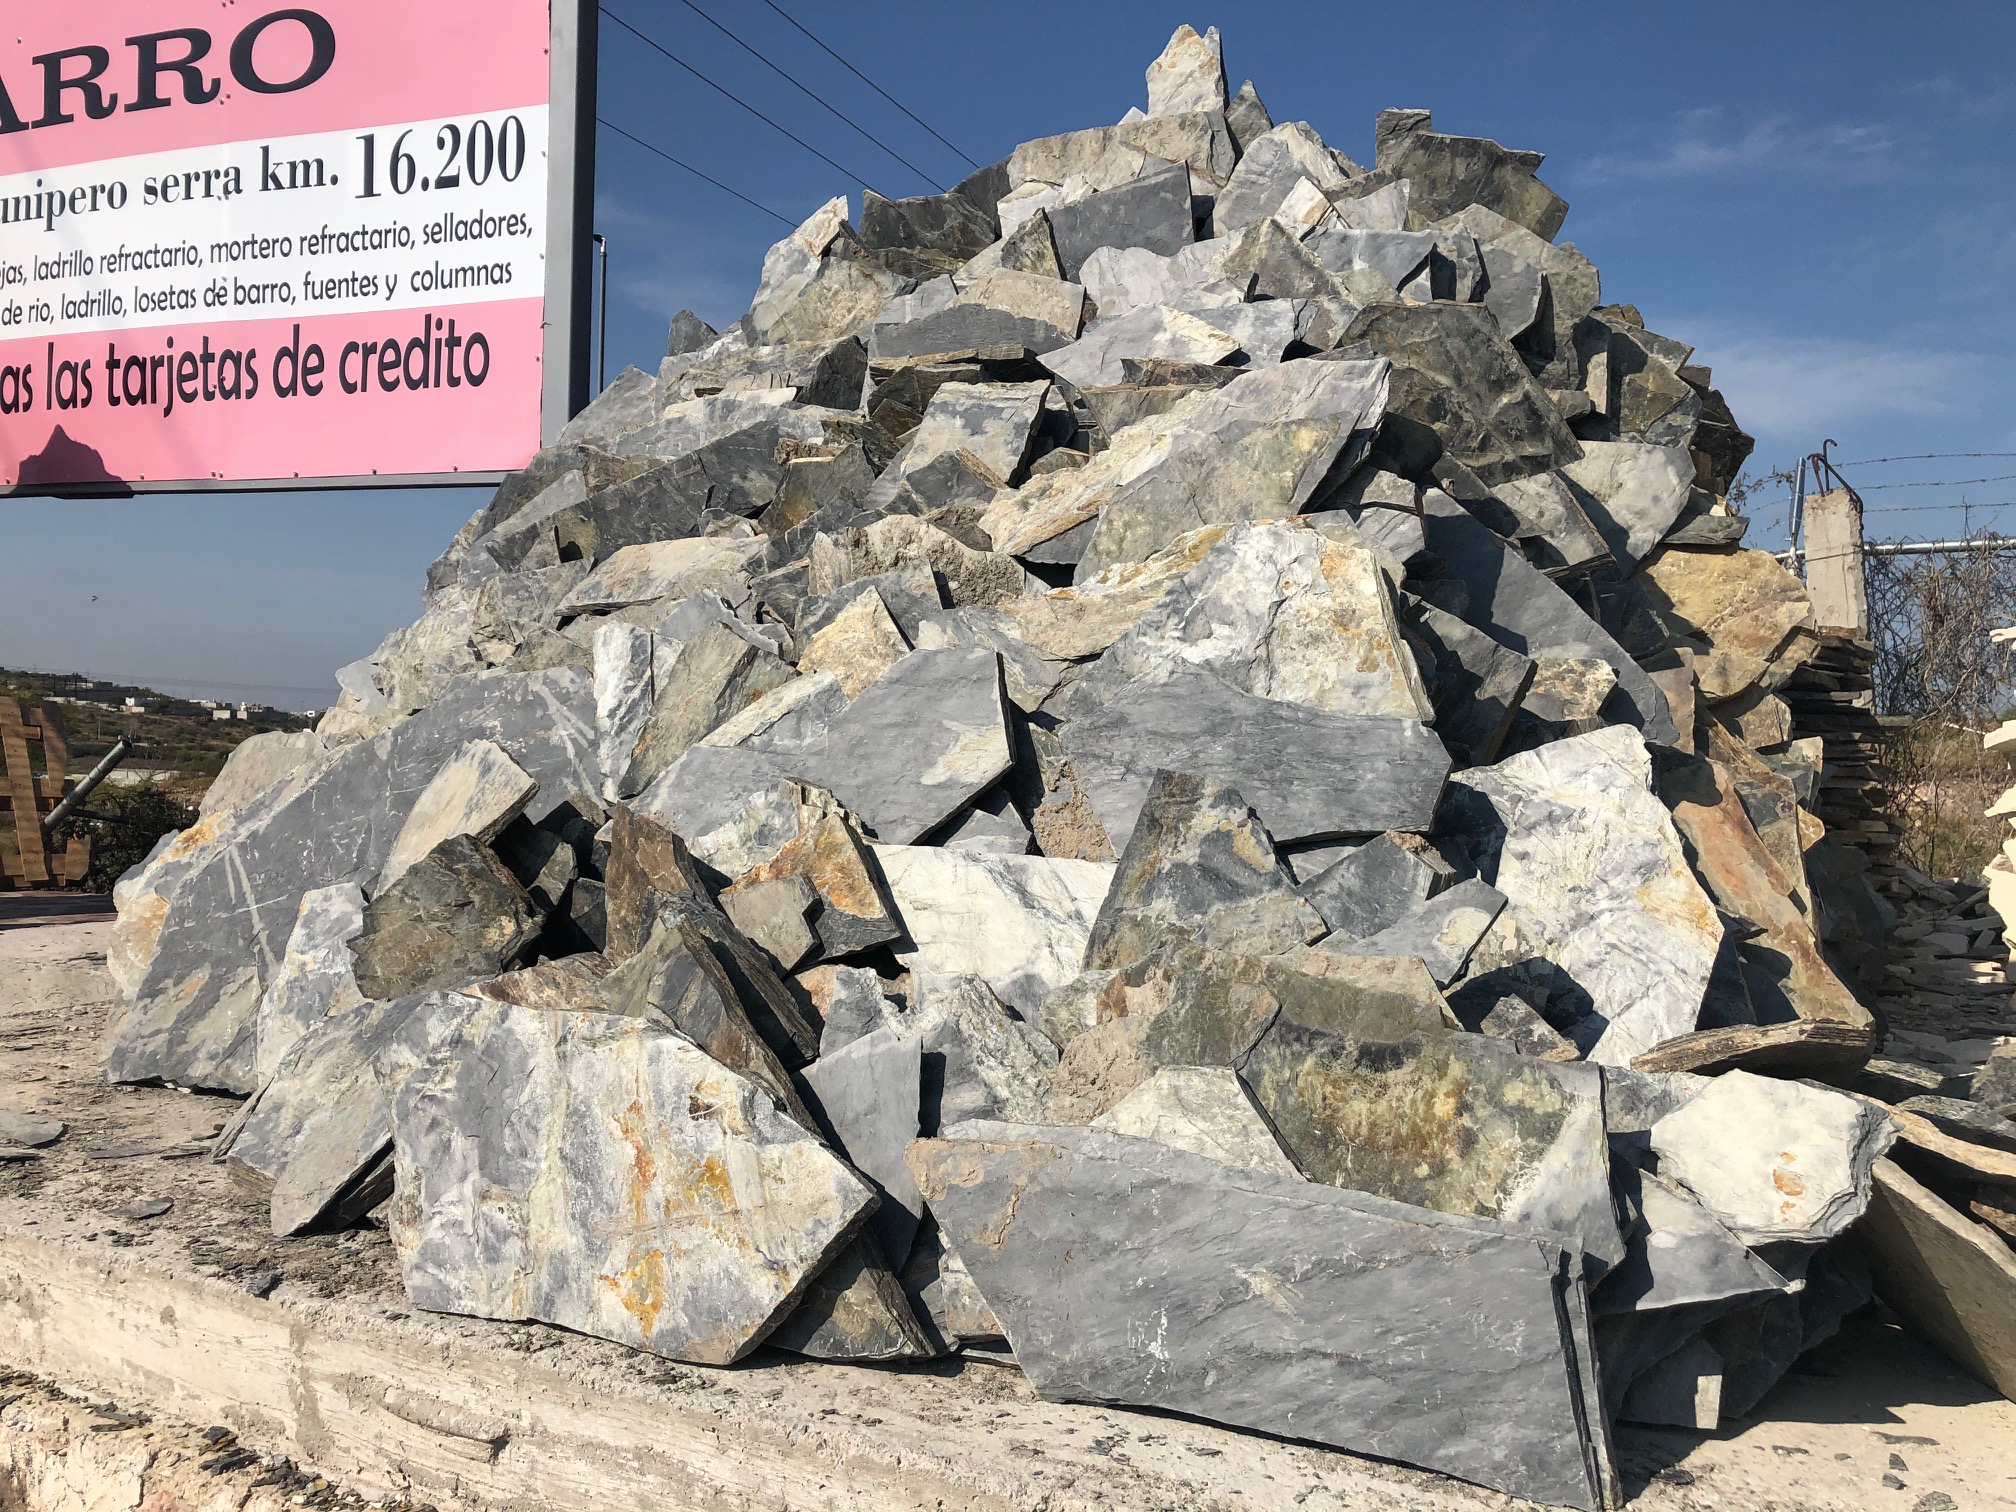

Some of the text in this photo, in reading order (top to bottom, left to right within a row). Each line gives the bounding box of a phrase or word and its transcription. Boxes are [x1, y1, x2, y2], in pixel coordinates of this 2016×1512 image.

[143, 165, 243, 206] serra
[259, 145, 339, 192] km.
[355, 115, 526, 199] 16.200
[0, 208, 532, 290] jas, ladrillo refractario, mortero refractario, selladores,
[1, 260, 512, 326] de rio, ladrillo, losetas de barro, fuentes y columnas
[46, 342, 92, 411] las
[105, 335, 259, 418] tarjetas
[272, 323, 325, 399] de
[339, 313, 490, 395] credito
